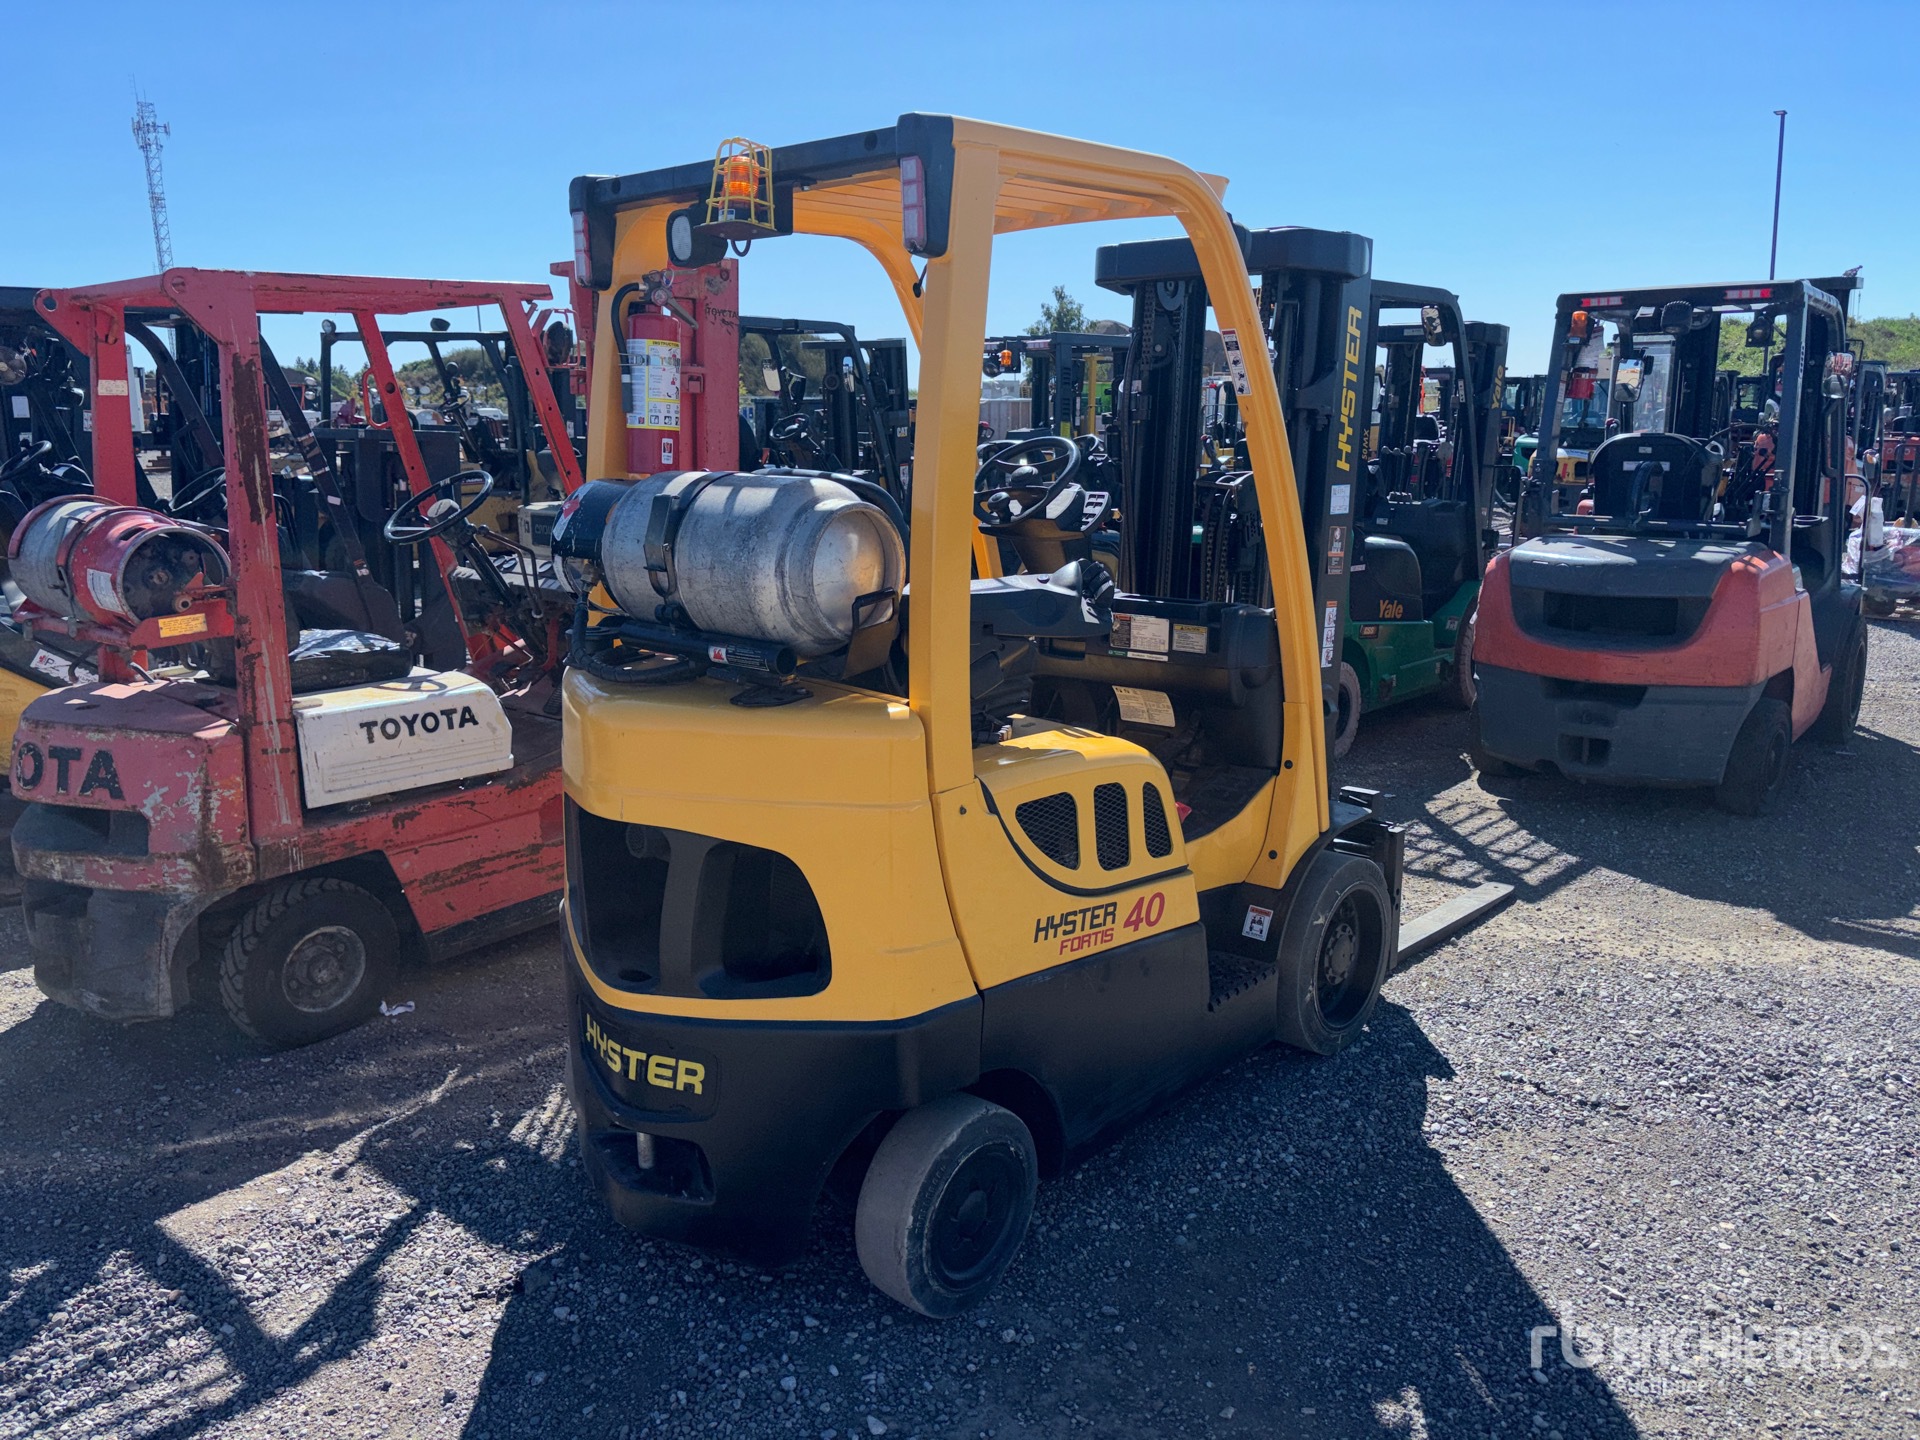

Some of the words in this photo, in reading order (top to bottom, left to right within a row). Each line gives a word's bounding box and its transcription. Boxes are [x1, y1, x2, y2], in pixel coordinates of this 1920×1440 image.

[1336, 305, 1363, 472] HYSTER
[1491, 364, 1504, 410] Yale
[896, 426, 909, 438] CAT
[1379, 599, 1404, 619] Yale
[359, 705, 480, 744] TOYOTA
[13, 740, 127, 802] OTA
[1033, 901, 1118, 944] HYSTER
[1122, 891, 1166, 933] 40
[1058, 927, 1115, 956] FORTIS
[586, 1013, 706, 1095] HYSTER
